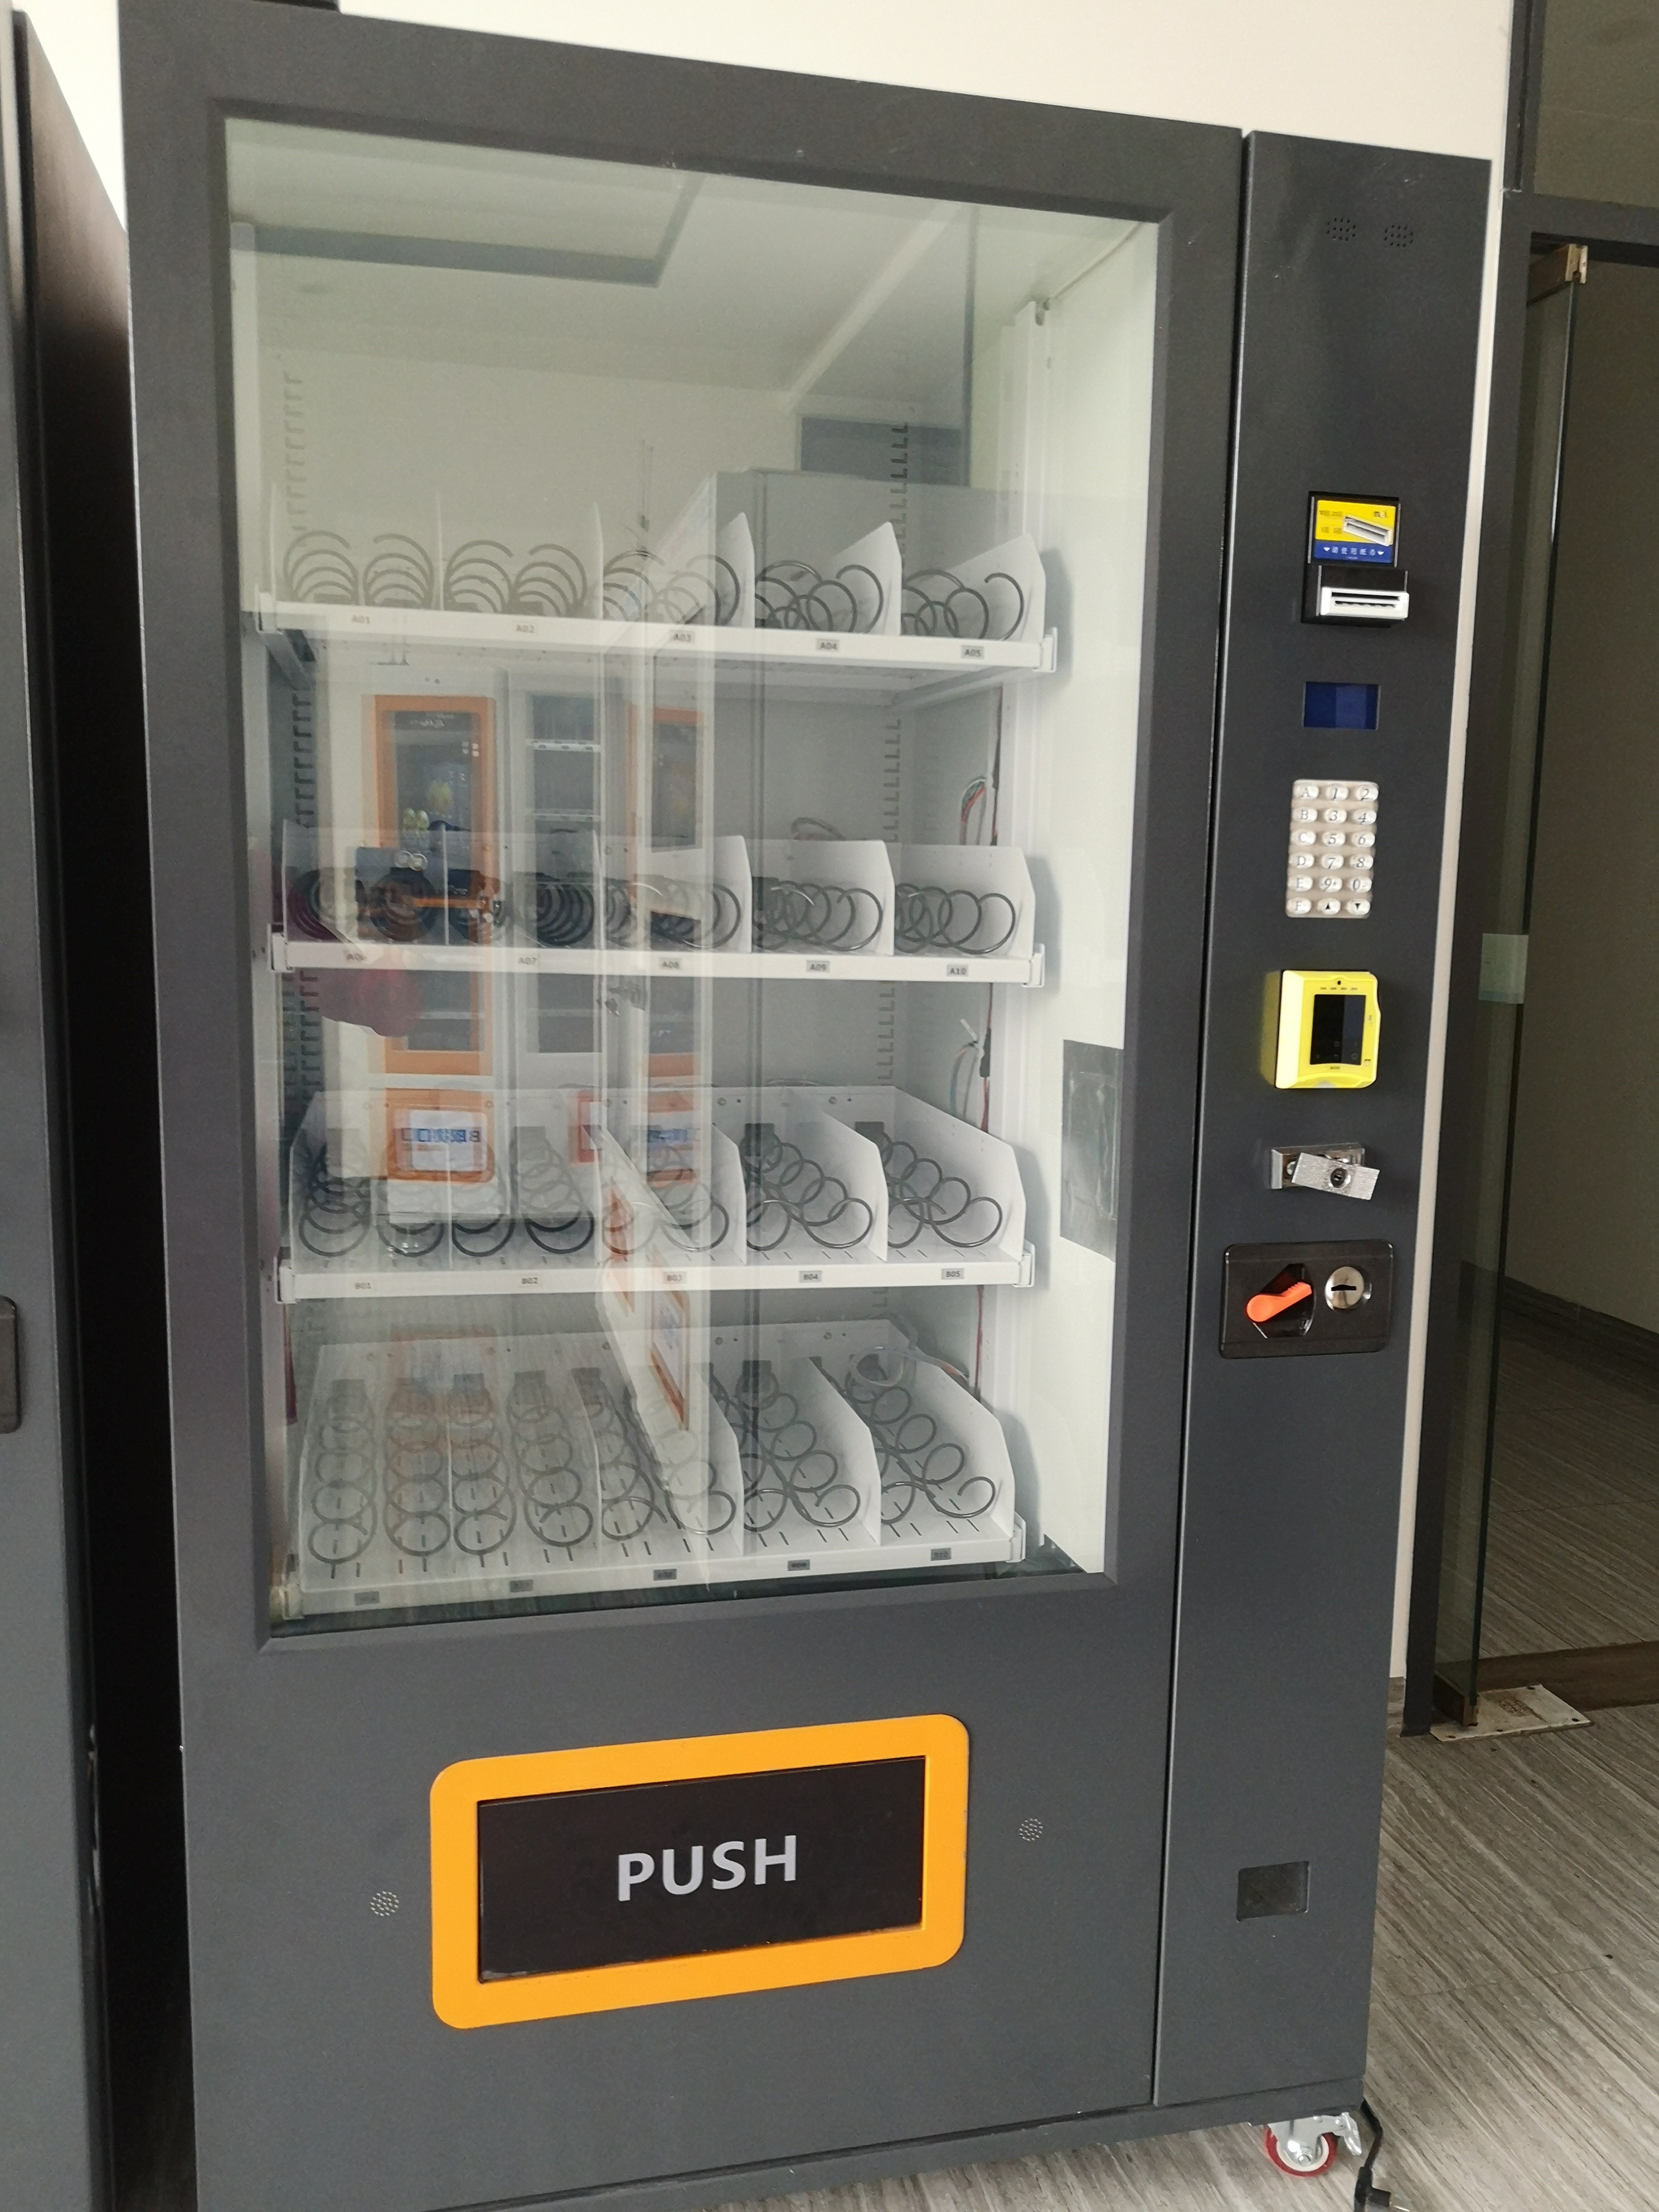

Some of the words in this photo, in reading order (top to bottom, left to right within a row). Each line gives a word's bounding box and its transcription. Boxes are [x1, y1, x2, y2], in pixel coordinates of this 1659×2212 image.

[516, 624, 535, 633] A02
[673, 633, 692, 642] A03
[820, 642, 837, 650] A04
[964, 648, 981, 657] A05
[1301, 787, 1311, 798] A
[1332, 787, 1338, 800] 1
[1360, 788, 1370, 801] 2
[1301, 809, 1309, 820] B
[1329, 810, 1338, 821] 3
[1358, 812, 1367, 824] 4
[1299, 832, 1308, 843] C
[1328, 833, 1337, 845] 5
[1358, 834, 1366, 845] 6
[1297, 856, 1306, 866] D
[1327, 857, 1336, 870] 7
[1356, 857, 1366, 868] 8
[1296, 878, 1304, 889] E
[1295, 901, 1302, 911] F
[618, 1835, 797, 1901] PUSH
